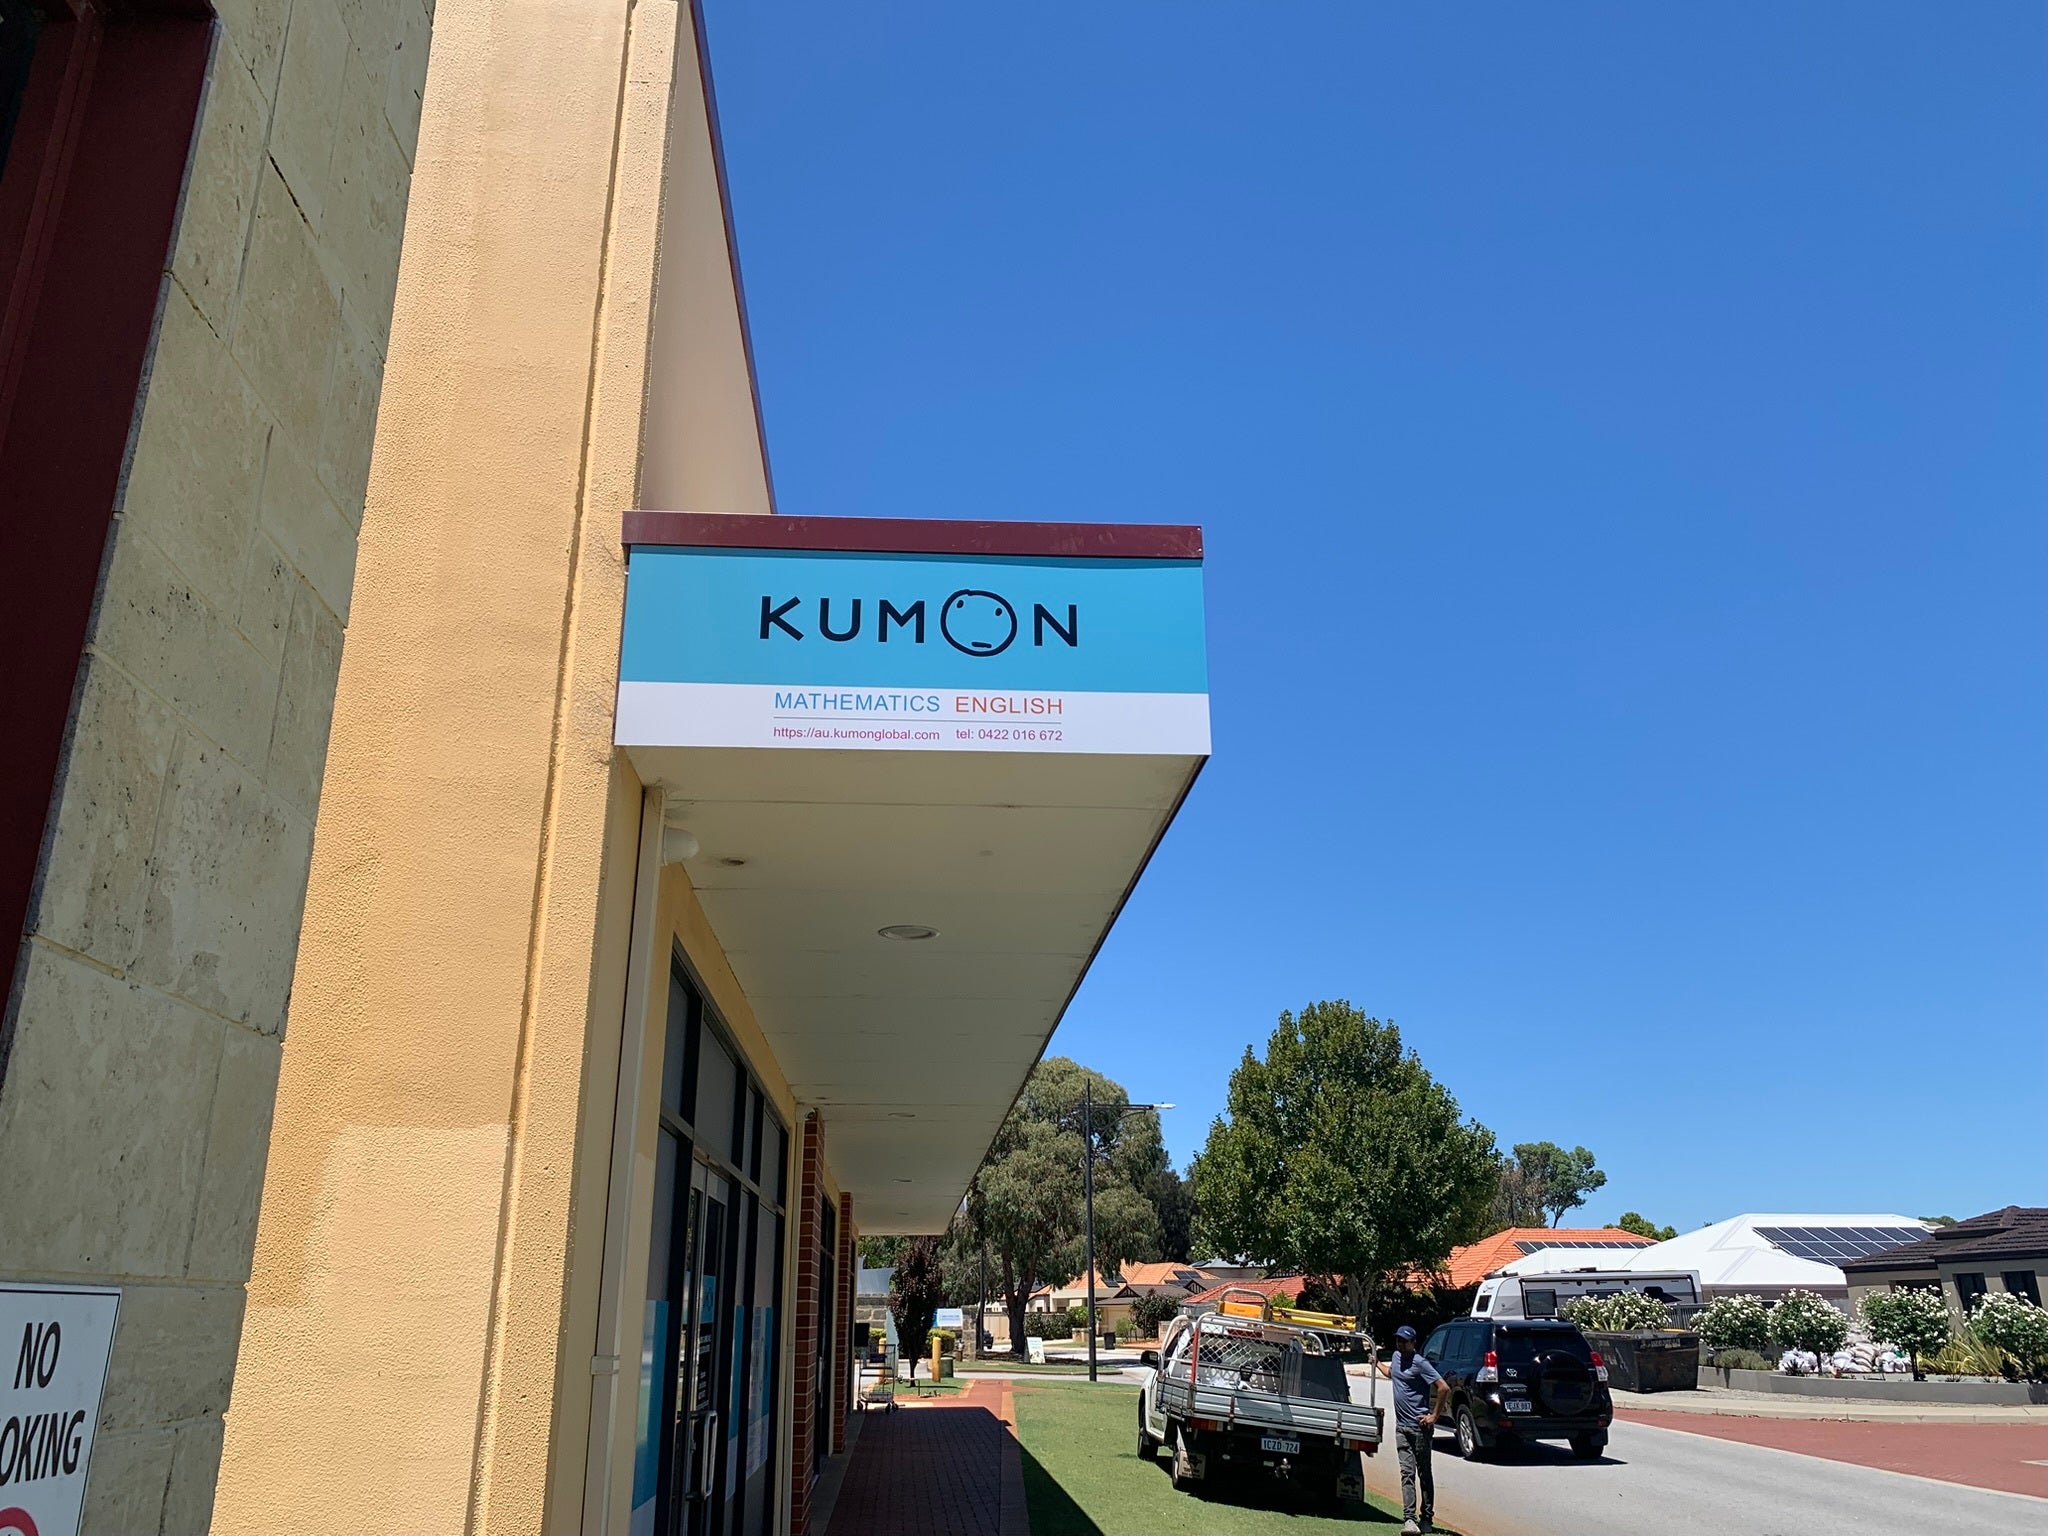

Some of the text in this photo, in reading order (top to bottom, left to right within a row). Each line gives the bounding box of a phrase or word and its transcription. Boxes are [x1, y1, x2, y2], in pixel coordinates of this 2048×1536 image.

[758, 588, 1079, 658] KUMON
[773, 725, 1063, 742] https://au.kumonglobal.com tel: 0422 016 672
[774, 691, 1063, 715] MATHEMATICS ENGLISH
[13, 1321, 62, 1390] NO
[0, 1409, 86, 1487] OKING
